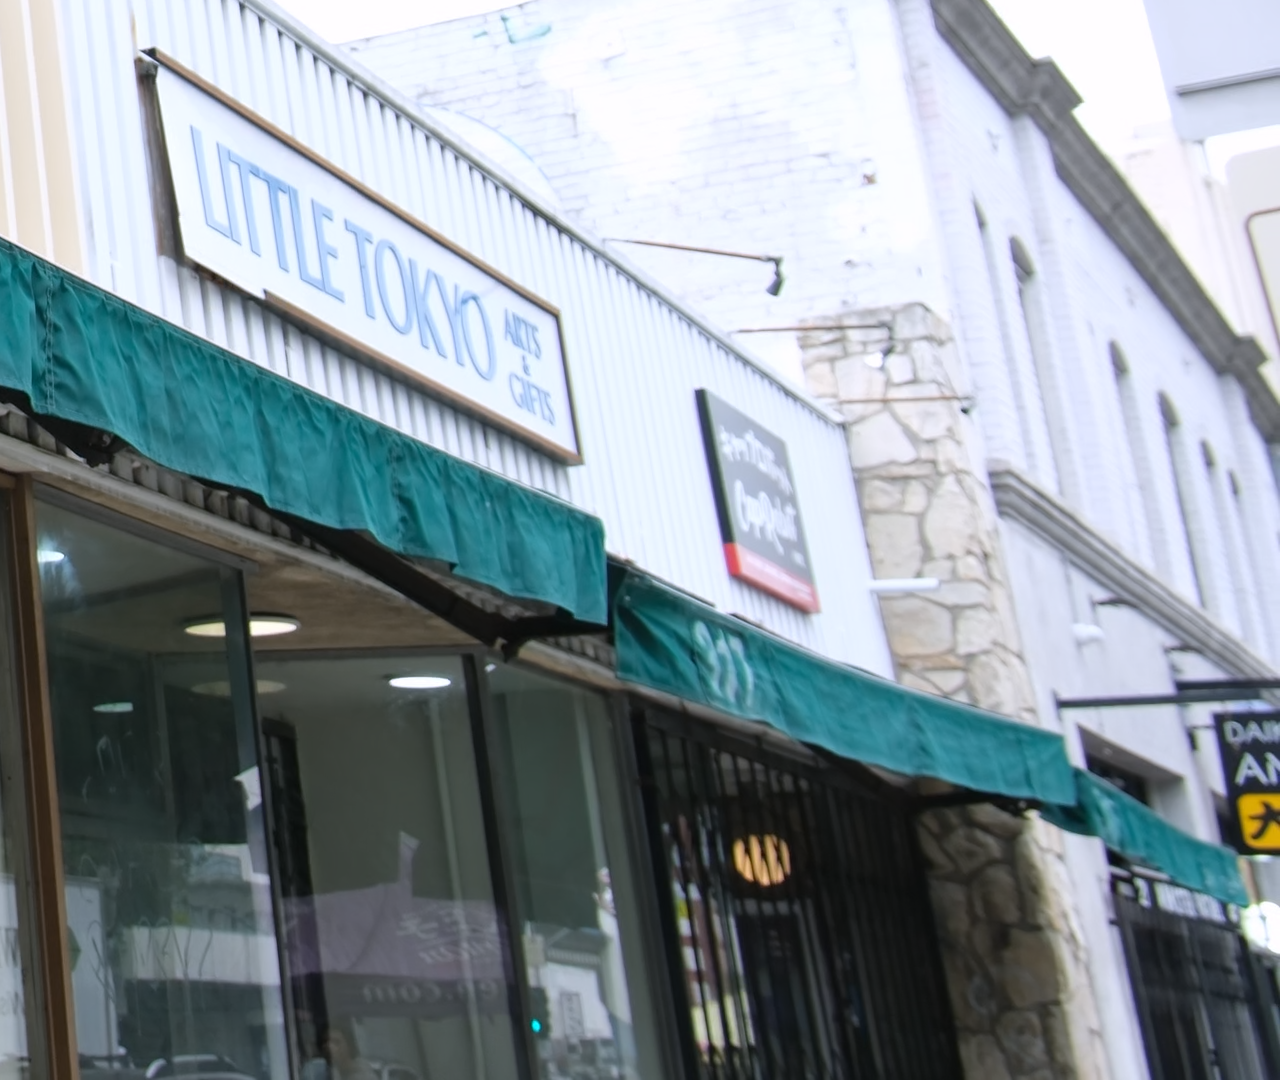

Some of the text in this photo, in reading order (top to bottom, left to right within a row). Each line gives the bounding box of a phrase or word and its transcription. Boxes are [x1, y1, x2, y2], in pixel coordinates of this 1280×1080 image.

[188, 123, 498, 383] LITTLE TOKYO
[503, 307, 544, 361] ARTS
[521, 354, 532, 378] &
[508, 371, 557, 427] GIFTS
